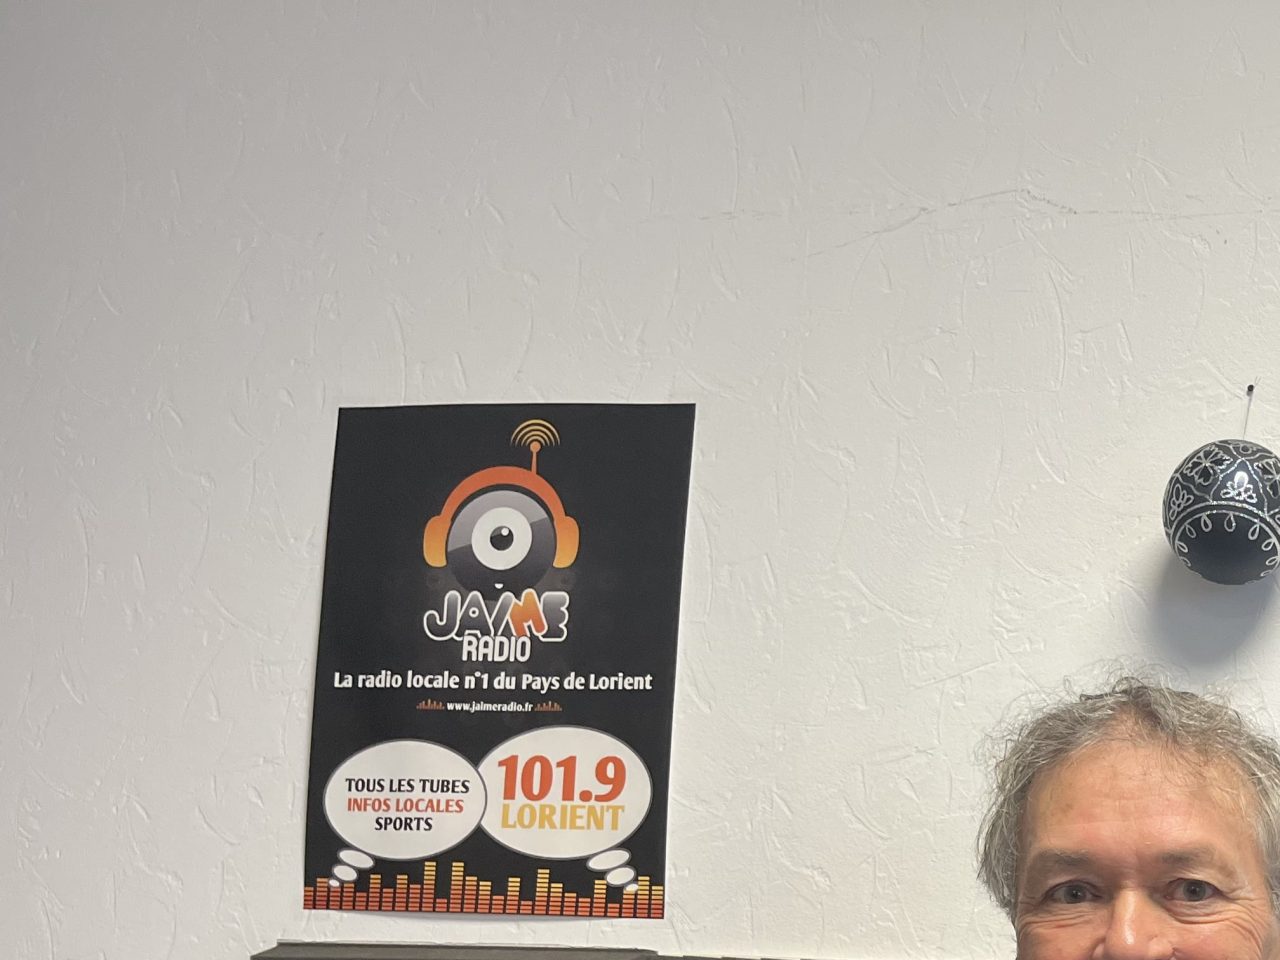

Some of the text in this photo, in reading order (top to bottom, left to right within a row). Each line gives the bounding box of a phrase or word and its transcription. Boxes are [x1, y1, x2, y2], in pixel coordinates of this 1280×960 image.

[462, 635, 531, 662] RADIO
[334, 672, 353, 688] La
[358, 670, 402, 688] radio
[407, 671, 459, 689] locale
[494, 672, 515, 690] du
[522, 674, 560, 694] Pays
[564, 673, 585, 690] de
[590, 672, 653, 691] Lorient
[447, 701, 533, 713] www.jaimeradio.fr
[345, 778, 470, 794] TOUS LES TUBES
[498, 755, 627, 802] 101.9
[347, 797, 464, 813] INFOS LOCALES
[374, 817, 433, 831] SPORTS
[501, 803, 625, 831] LORIENT
